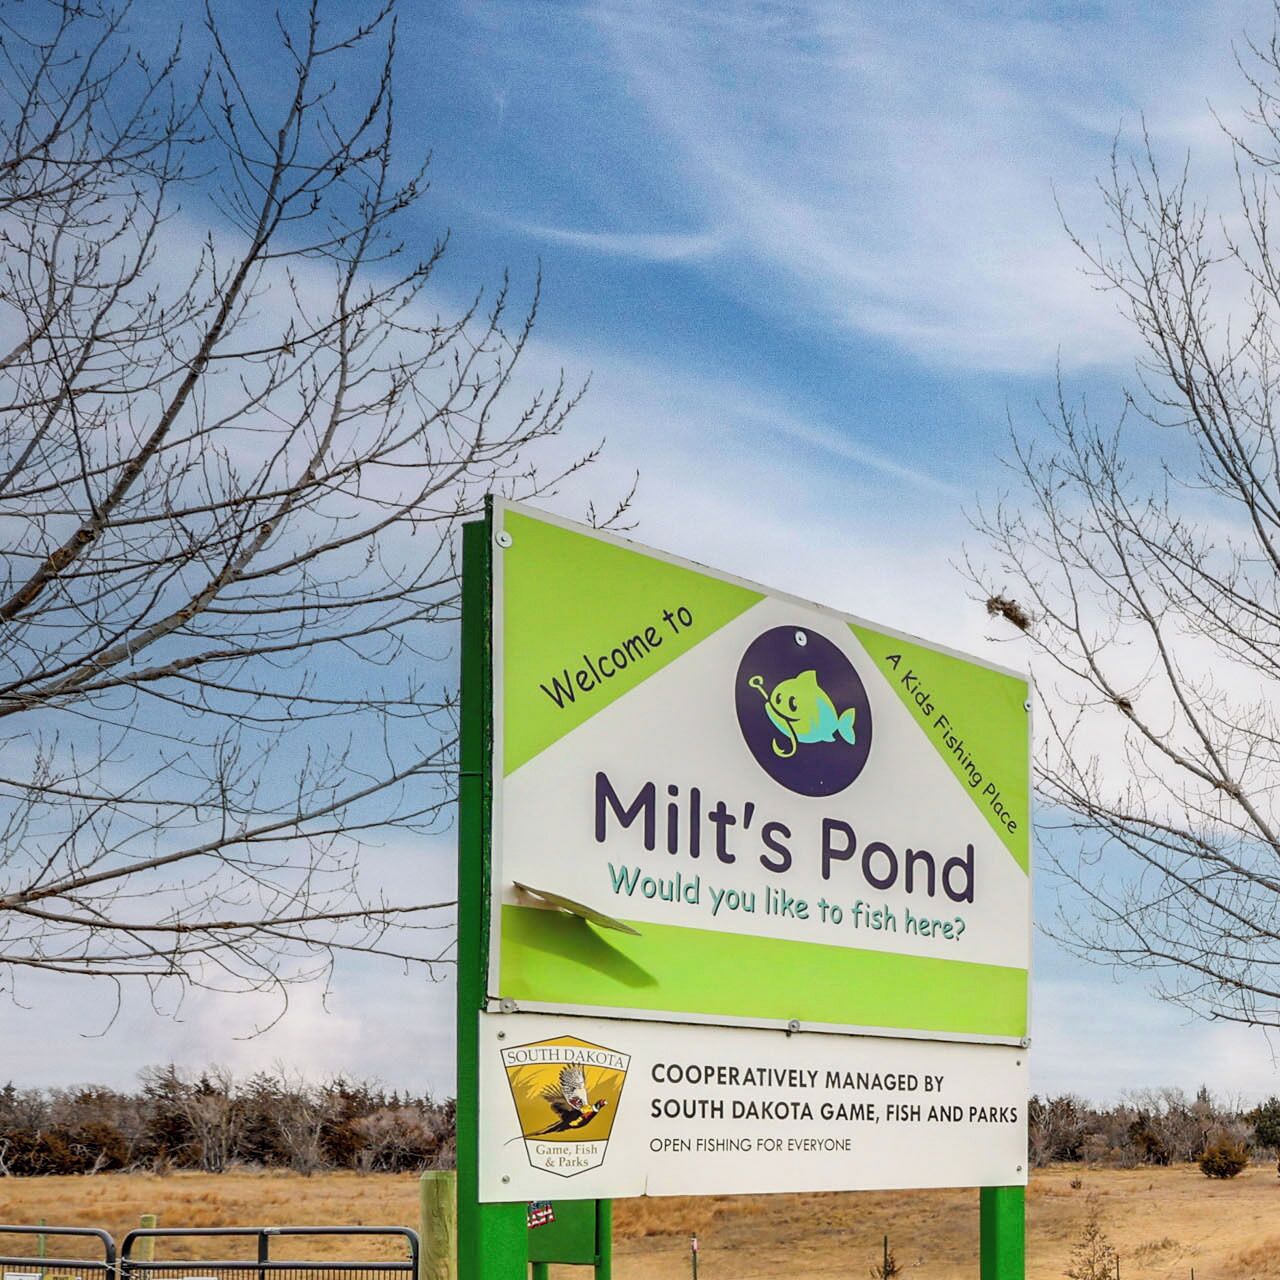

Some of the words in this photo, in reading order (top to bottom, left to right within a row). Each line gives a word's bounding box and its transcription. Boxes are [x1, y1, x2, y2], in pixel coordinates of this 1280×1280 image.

[539, 625, 663, 709] Welcome
[662, 606, 693, 634] to
[885, 653, 902, 671] A
[900, 669, 935, 716] Kids
[932, 714, 983, 788] Fishing
[982, 782, 1017, 834] Place
[595, 771, 792, 874] Milt's
[821, 817, 975, 904] Pond
[608, 862, 700, 904] Would
[709, 886, 755, 916] you
[765, 885, 809, 920] like
[817, 897, 843, 925] to
[852, 900, 897, 933] fish
[905, 908, 966, 941] here?
[507, 1048, 559, 1064] SOUTH
[564, 1048, 625, 1069] DAKOTA
[651, 1063, 819, 1089] COOPERATIVELY
[825, 1071, 919, 1092] MANAGED
[924, 1075, 944, 1092] BY
[650, 1098, 724, 1120] SOUTH
[732, 1100, 814, 1121] DAKOTA
[820, 1102, 880, 1124] GAME,
[886, 1104, 921, 1122] FISH
[927, 1105, 964, 1122] AND
[969, 1106, 1018, 1124] PARKS
[536, 1144, 572, 1156] Game,
[575, 1143, 598, 1155] Fish
[649, 1138, 691, 1153] OPEN
[696, 1138, 752, 1152] FISHING
[757, 1138, 783, 1152] FOR
[787, 1138, 851, 1152] EVERYONE
[545, 1158, 556, 1168] &
[558, 1156, 589, 1168] Parks
